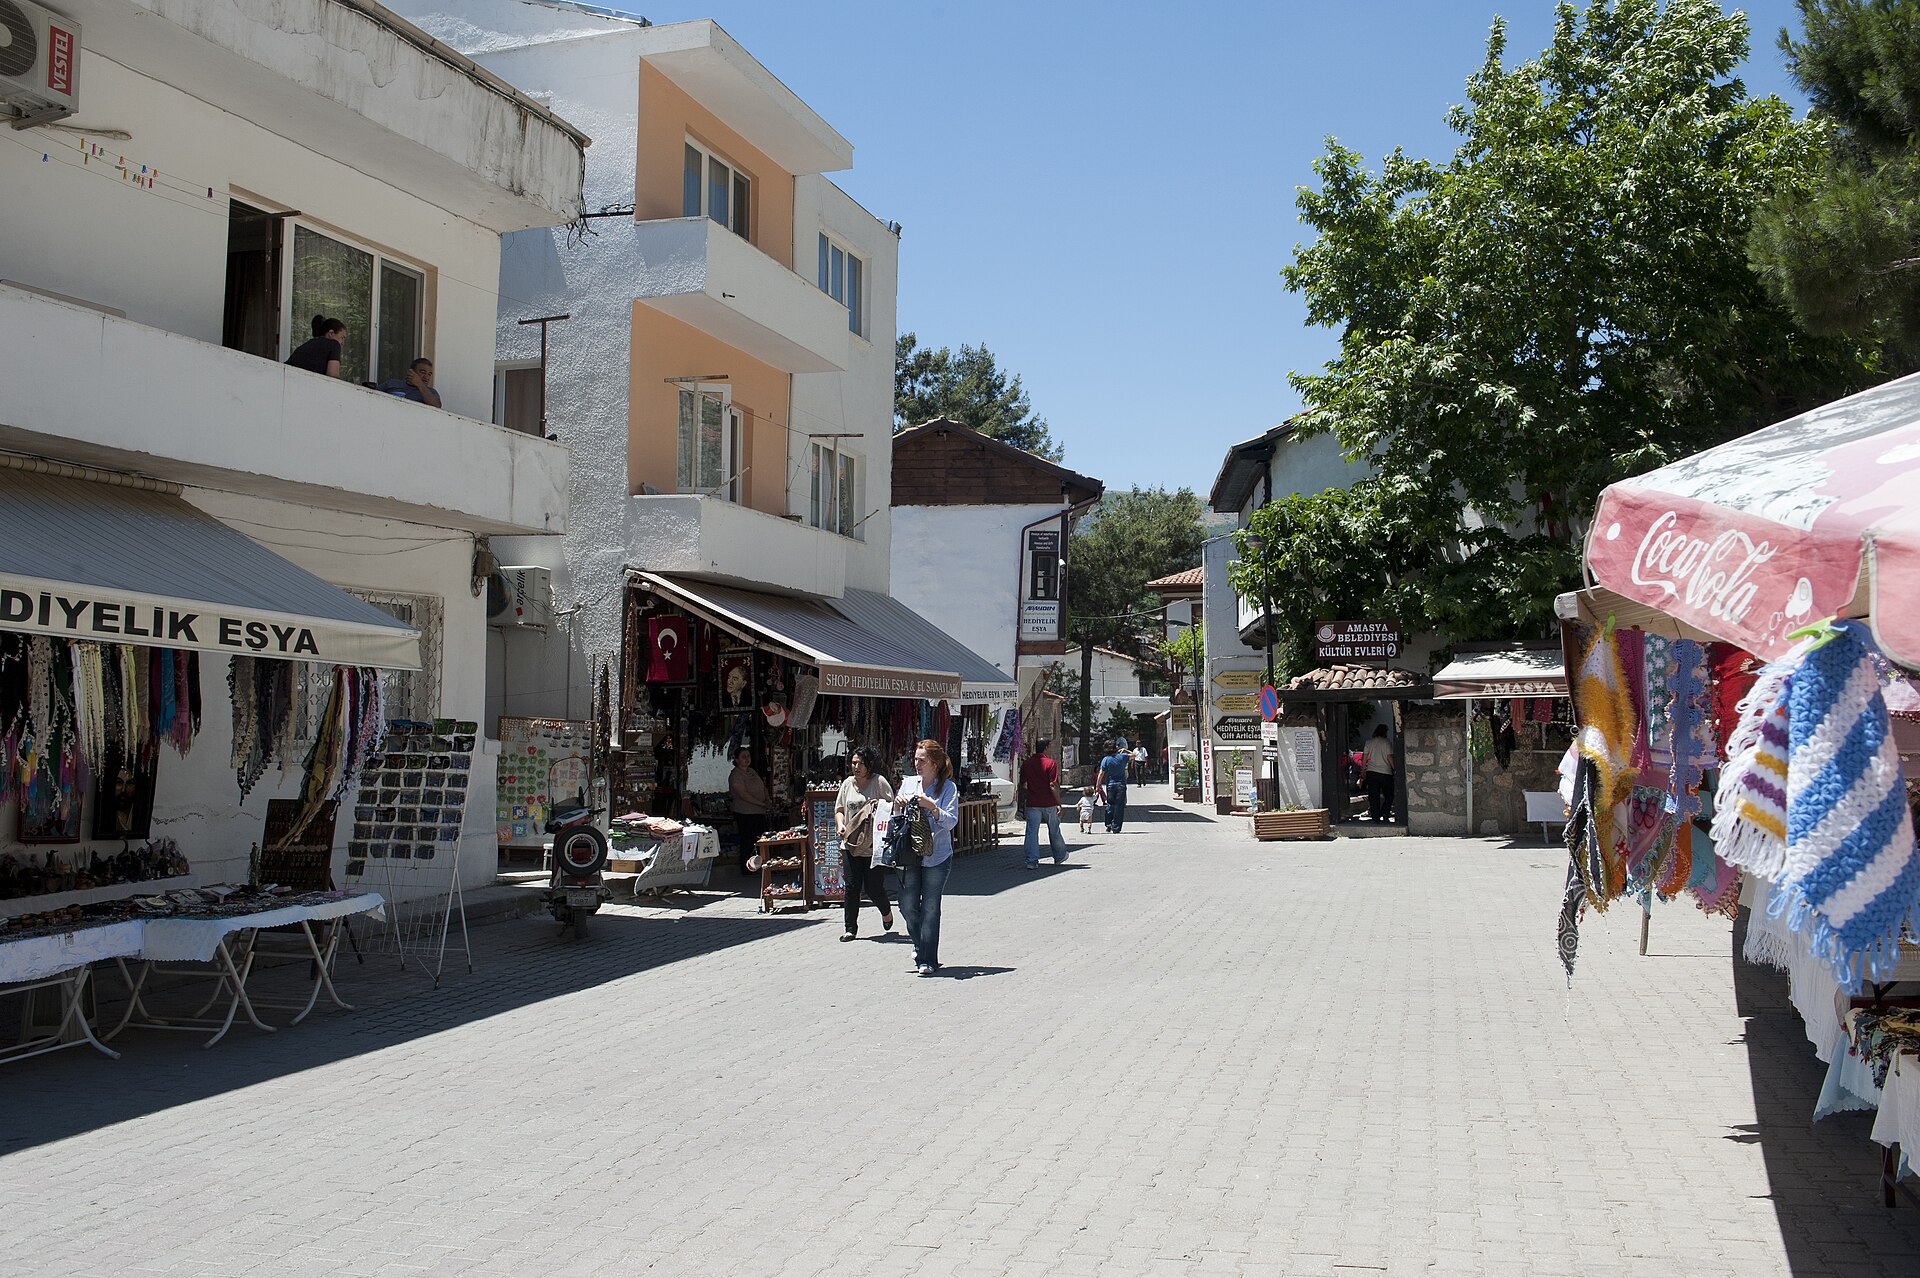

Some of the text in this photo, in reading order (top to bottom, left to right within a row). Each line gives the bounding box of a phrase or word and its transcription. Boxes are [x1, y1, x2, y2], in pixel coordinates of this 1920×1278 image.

[53, 33, 69, 89] VESTEL
[1631, 511, 1779, 624] Coca-Cola
[0, 589, 319, 655] DİYELİK EŞYA
[1023, 617, 1056, 625] HEDİYELİK
[1346, 623, 1389, 633] AMASYA
[1337, 631, 1398, 643] BELEDİYESİ
[1319, 643, 1396, 657] KÜLTÜR EVLERİ 2
[825, 673, 850, 687] SHOP
[851, 674, 890, 691] HEDİYELİK
[891, 679, 909, 693] EŞYA
[909, 681, 915, 692] &
[917, 681, 925, 692] EL
[1482, 681, 1557, 694] AMASYA
[1216, 723, 1246, 732] HEDİYELİK
[1247, 725, 1262, 733] EŞYA
[876, 820, 889, 832] di
